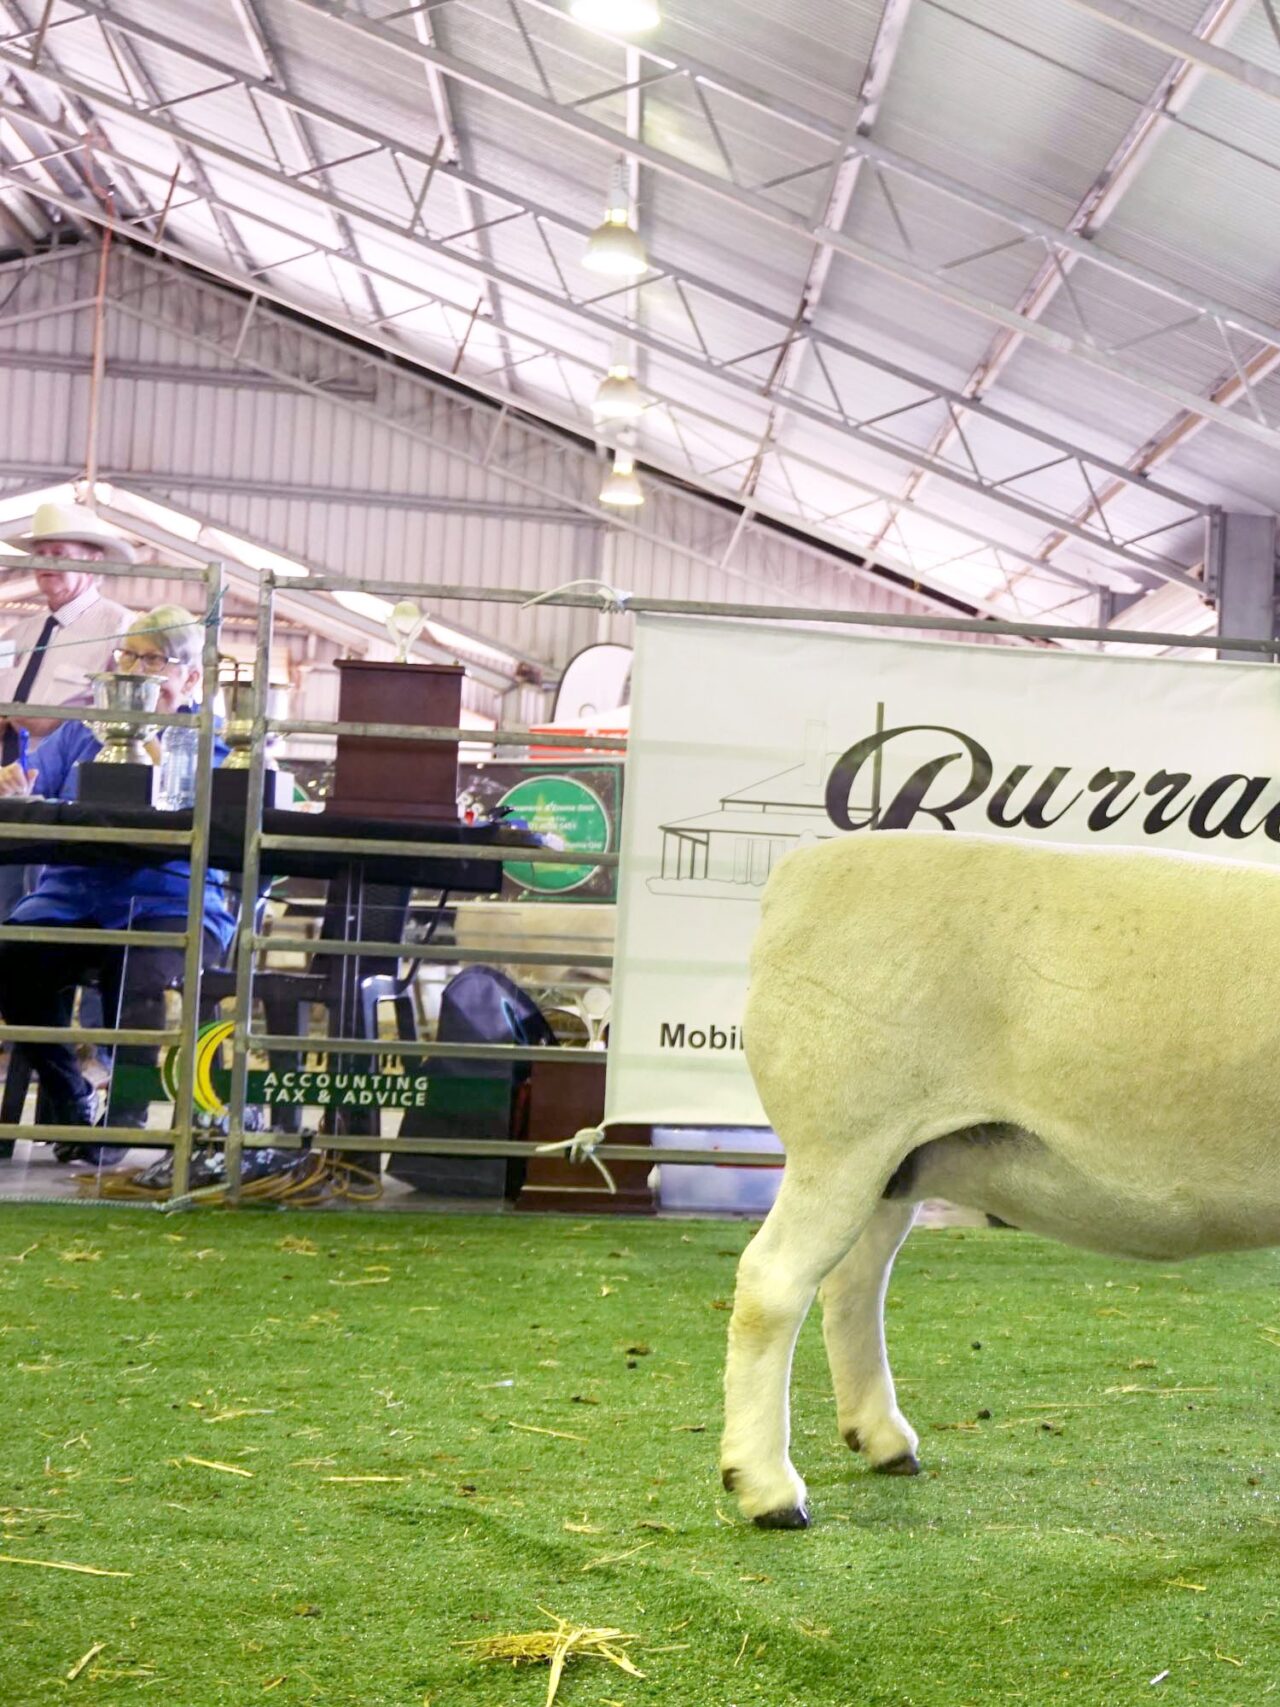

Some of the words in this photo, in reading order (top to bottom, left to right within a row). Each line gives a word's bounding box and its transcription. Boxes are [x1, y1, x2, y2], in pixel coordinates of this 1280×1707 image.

[263, 1071, 429, 1091] ACCOUNTING
[263, 1088, 306, 1104] TAX
[317, 1089, 332, 1104] &
[342, 1090, 427, 1107] ADVICE
